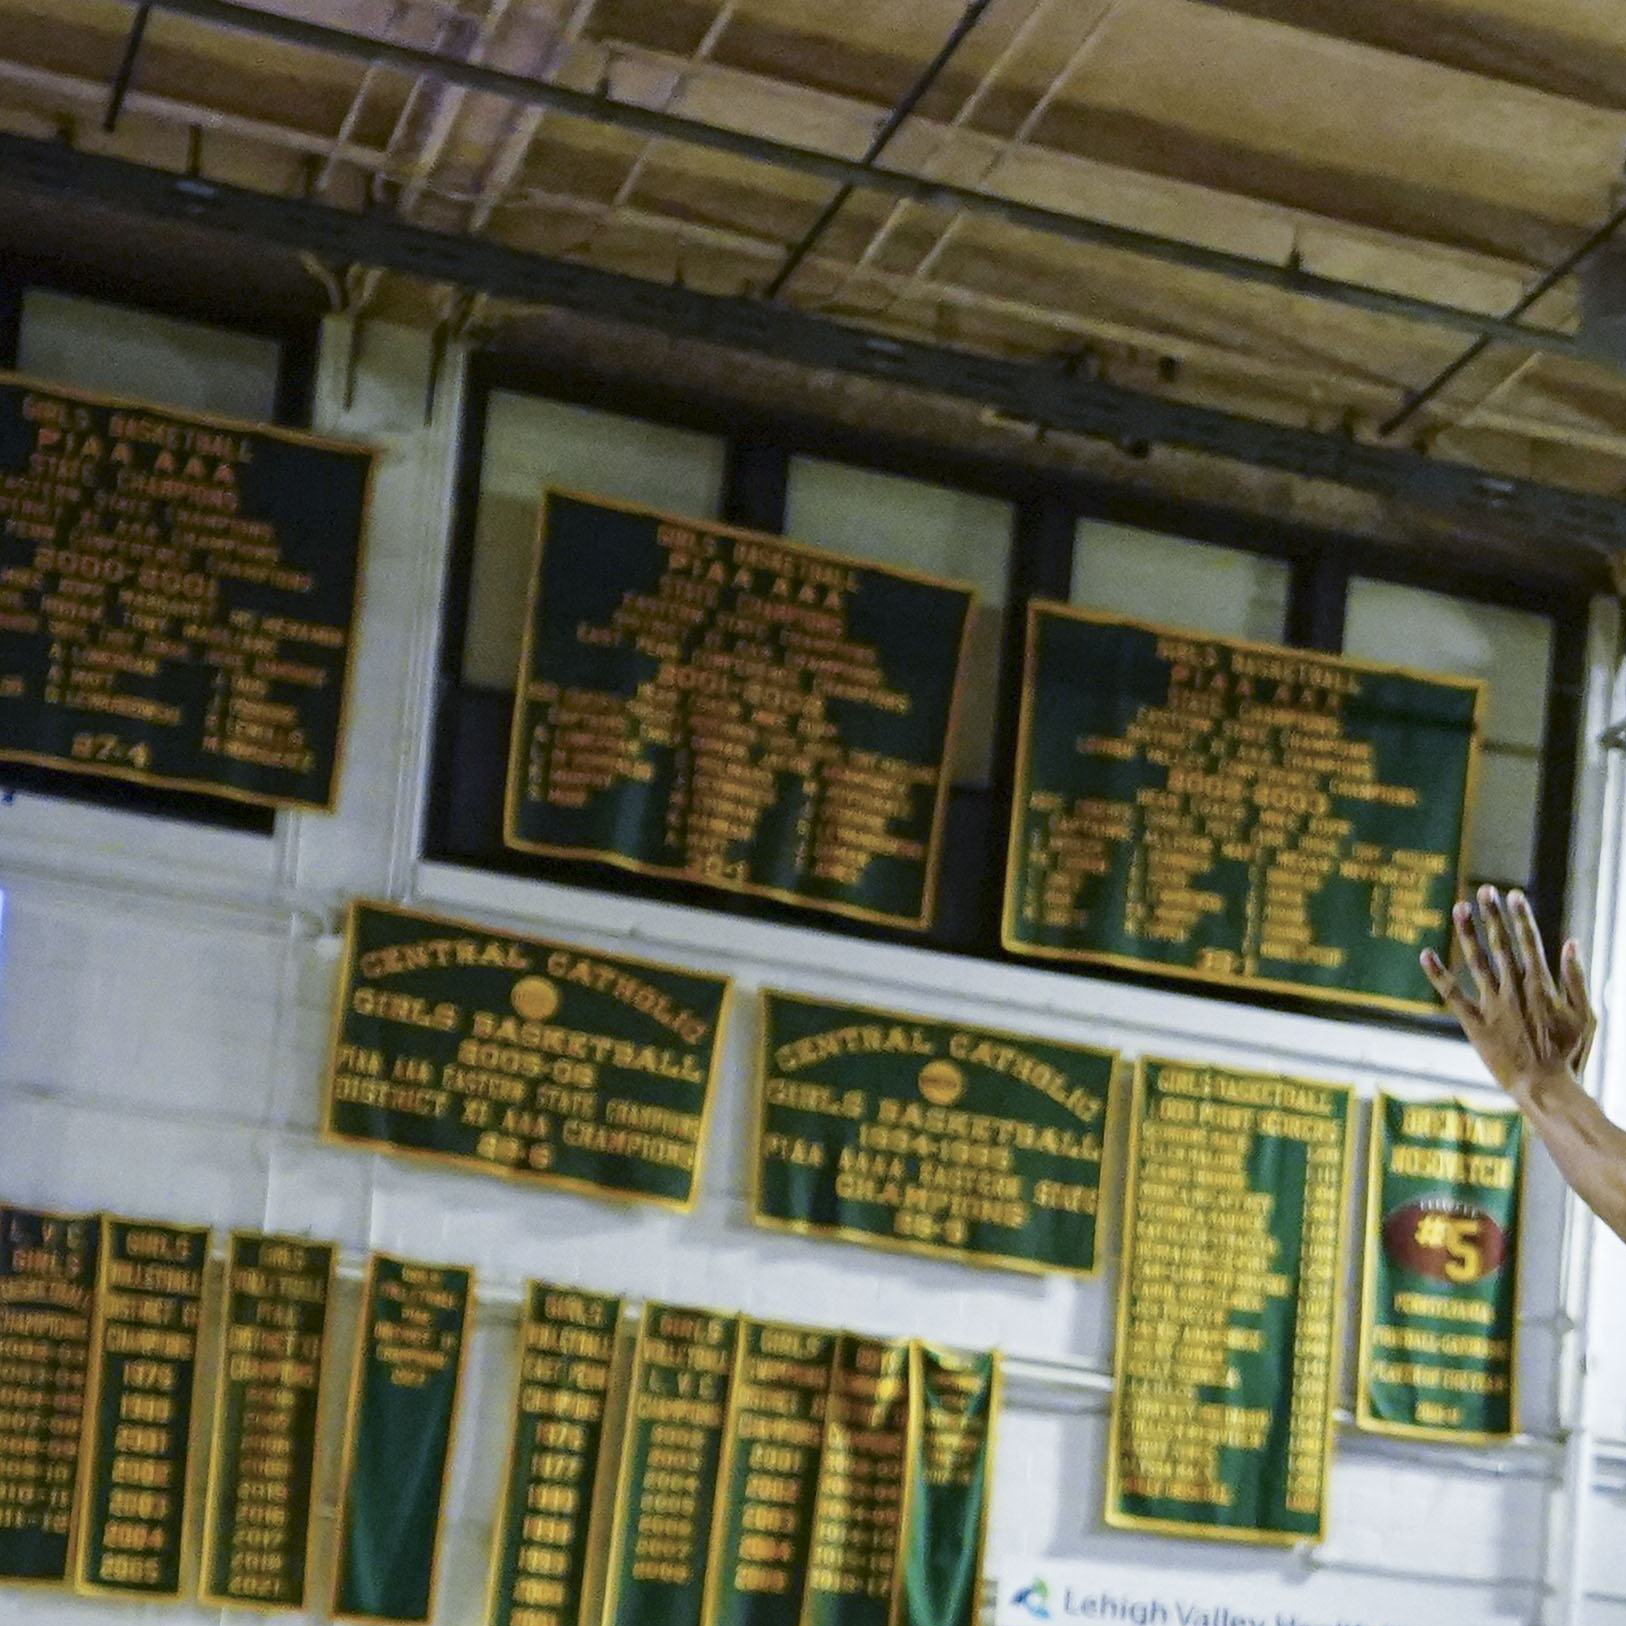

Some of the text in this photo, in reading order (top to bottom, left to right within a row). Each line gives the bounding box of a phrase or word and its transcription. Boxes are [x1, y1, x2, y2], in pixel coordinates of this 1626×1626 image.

[360, 938, 708, 1045] CENTRAL CATHOLIC
[473, 1010, 704, 1084] BASKETBALL
